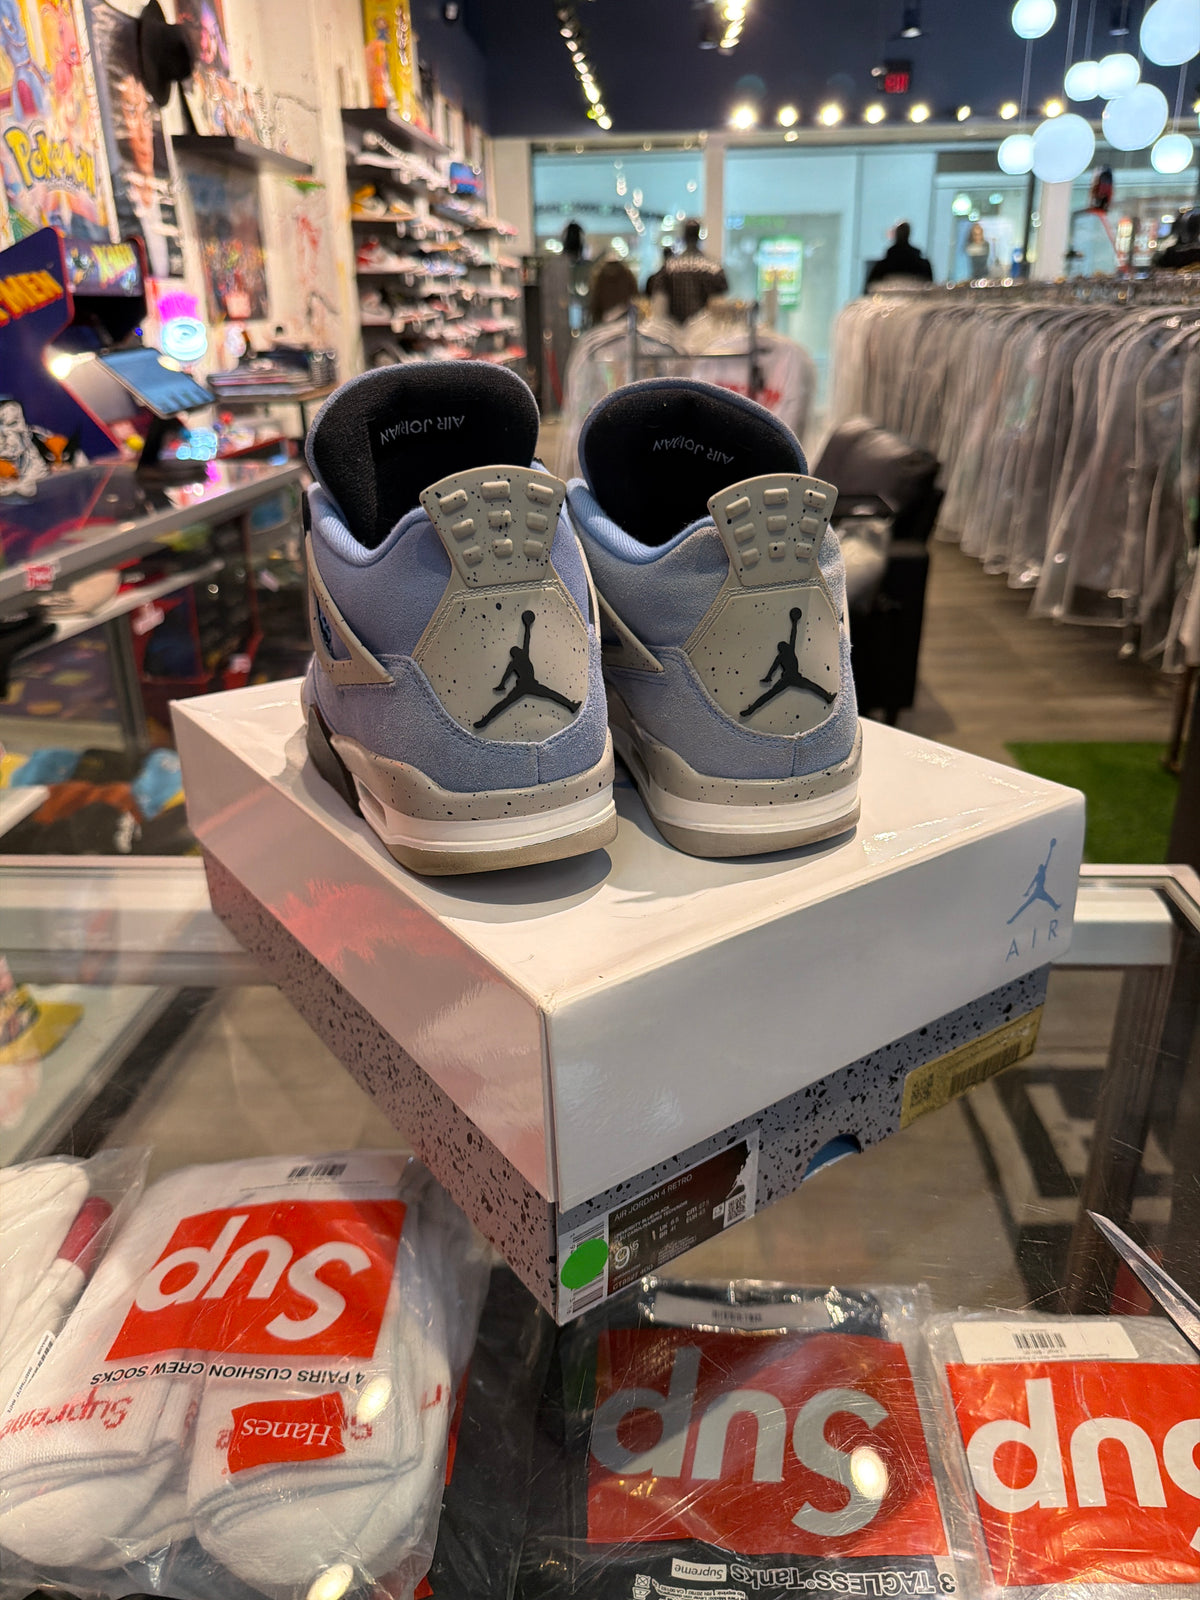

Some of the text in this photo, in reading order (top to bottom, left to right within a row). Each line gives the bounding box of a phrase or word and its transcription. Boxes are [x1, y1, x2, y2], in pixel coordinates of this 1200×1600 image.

[436, 415, 466, 431] AIR
[706, 447, 735, 465] AIR
[1005, 918, 1059, 963] AIR
[614, 1173, 693, 1221] AIR JORDAN 4 RETRO
[136, 1214, 372, 1342] Sup
[89, 1361, 366, 1386] 4 PAIRS CUSHION CREW SOCKS
[240, 1418, 335, 1447] Hanes
[590, 1345, 890, 1538] Sup
[674, 1563, 724, 1580] Supreme
[730, 1563, 806, 1590] Tanks
[937, 1572, 958, 1594] 3
